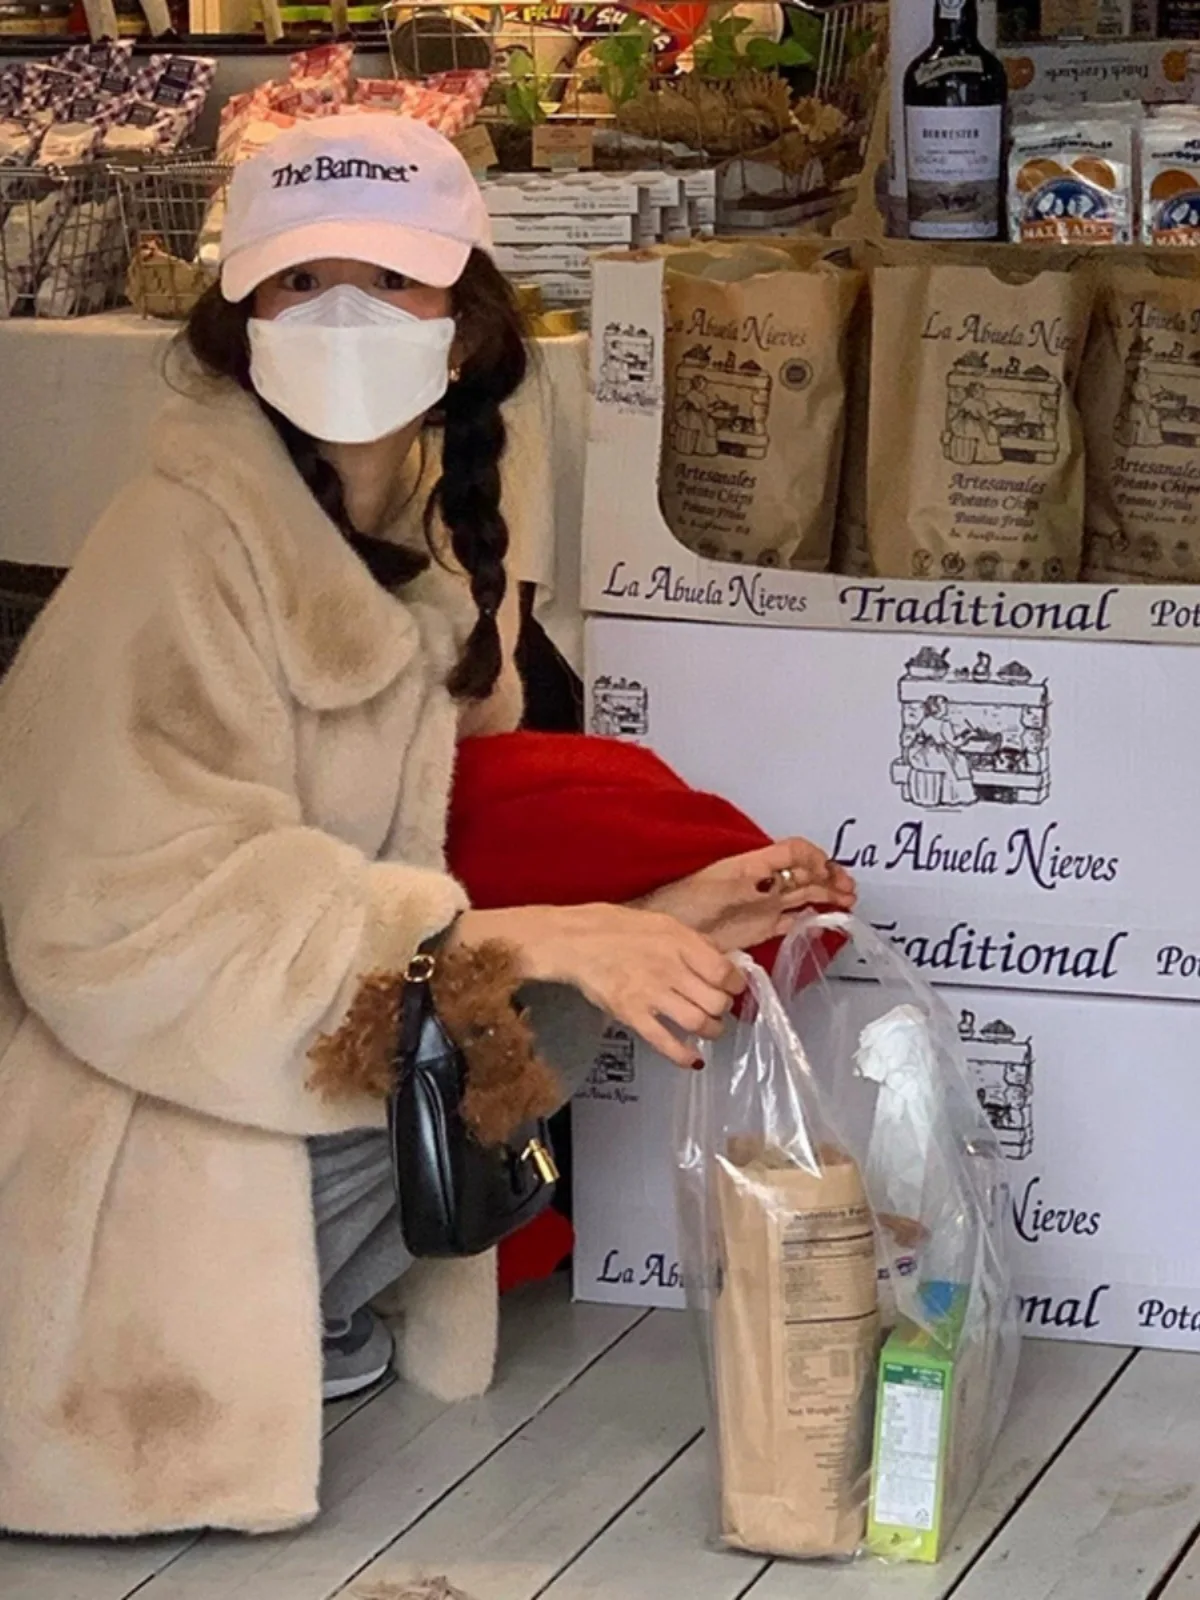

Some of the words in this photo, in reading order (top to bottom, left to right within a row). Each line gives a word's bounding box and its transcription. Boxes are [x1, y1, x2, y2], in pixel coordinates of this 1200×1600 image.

[272, 162, 312, 188] The
[741, 312, 806, 352] Nieves
[921, 311, 950, 340] La
[956, 313, 1025, 347] Abuela
[948, 472, 1047, 495] Artesanales
[602, 561, 640, 597] La
[645, 566, 723, 605] Abuela
[729, 573, 807, 616] Nieves
[839, 585, 1119, 632] Traditional
[829, 818, 877, 868] La
[885, 820, 998, 875] Abuela
[1005, 822, 1118, 889] Nieves
[597, 1250, 634, 1285] La
